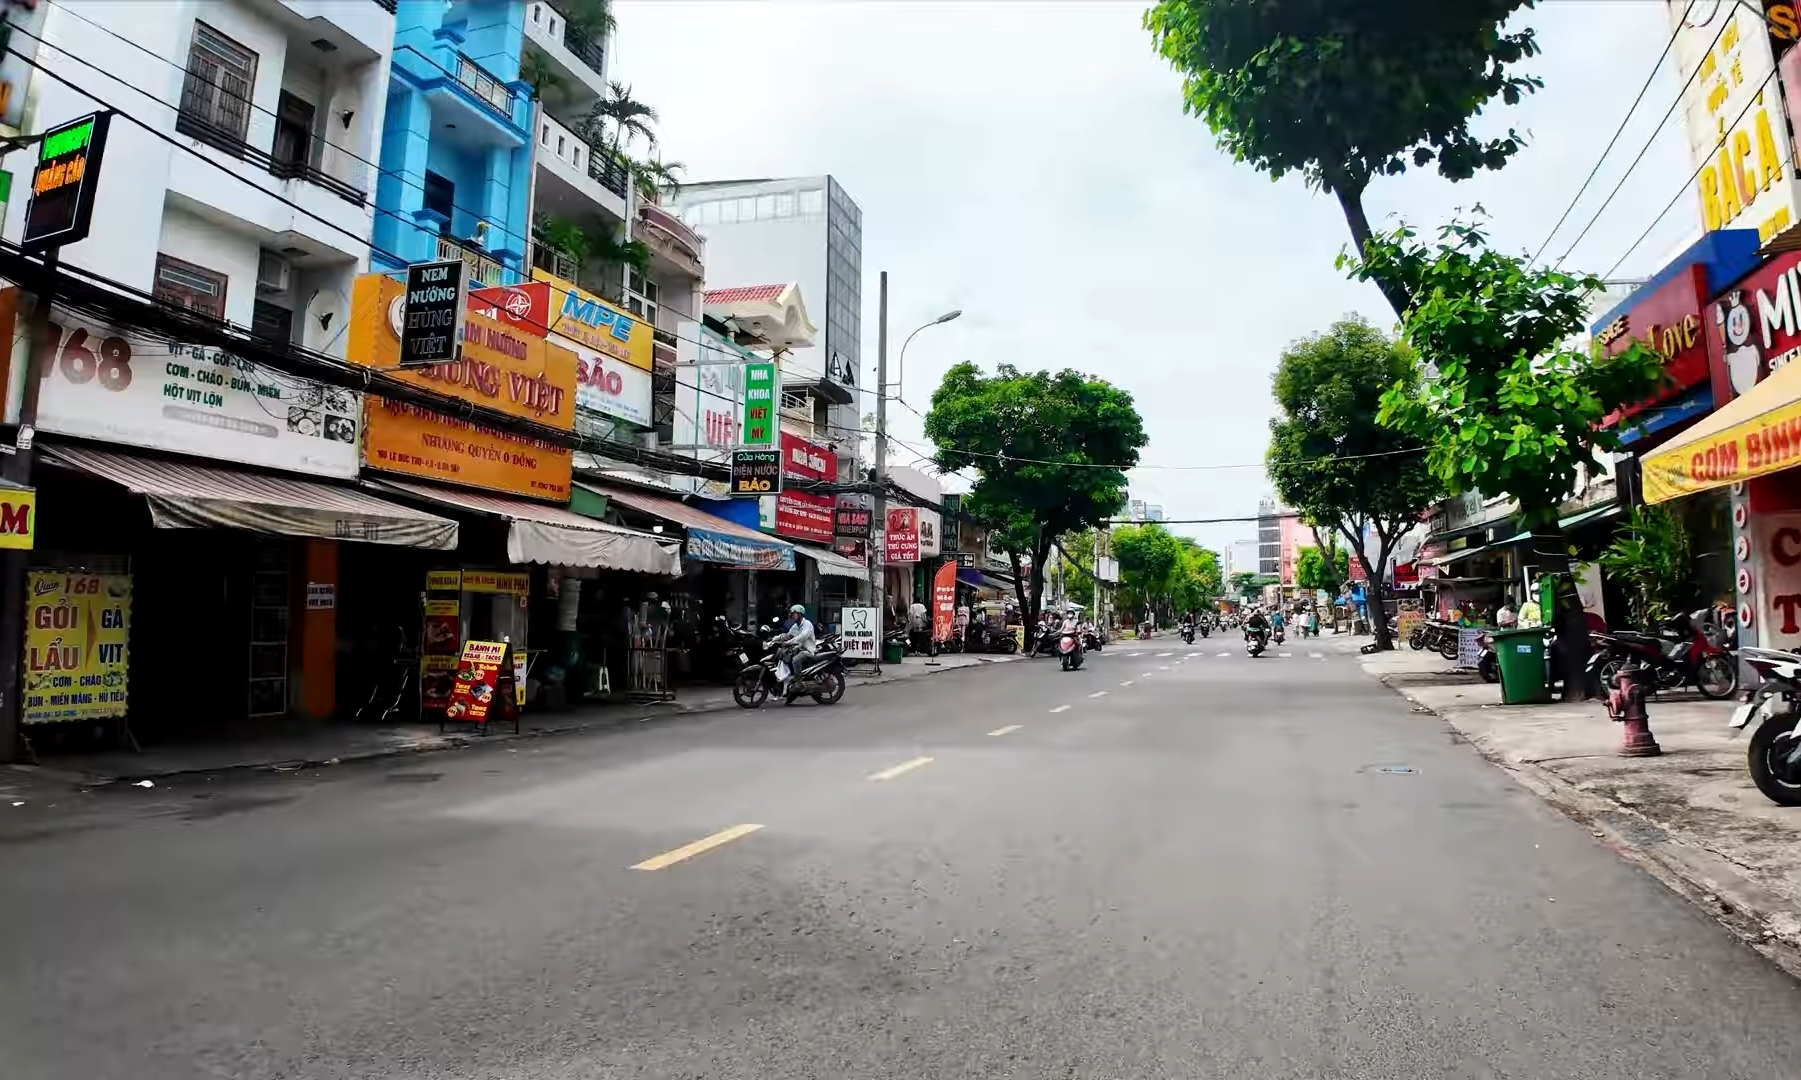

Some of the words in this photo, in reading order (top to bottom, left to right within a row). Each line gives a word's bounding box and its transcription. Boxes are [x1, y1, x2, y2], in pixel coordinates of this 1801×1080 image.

[422, 267, 448, 283] NEM
[410, 286, 456, 305] NƯỚNG
[1756, 261, 1801, 349] MI
[408, 307, 453, 329] HÙNG
[561, 288, 633, 342] MPE
[411, 331, 447, 359] VIỆT
[166, 362, 190, 379] CƠM
[197, 369, 223, 386] CHÁO
[751, 369, 768, 381] NHA
[164, 382, 184, 401] HỘT
[186, 388, 201, 405] VỊT
[748, 388, 770, 400] KHOA
[755, 453, 775, 463] Hàng
[1691, 440, 1738, 482] CƠM
[733, 463, 753, 477] ĐIỆN
[755, 463, 779, 476] NƯỚC
[738, 477, 771, 491] BẢO
[903, 552, 915, 560] TỐT
[64, 578, 100, 595] 168
[101, 606, 124, 629] GÀ
[857, 630, 873, 638] KHOA
[99, 644, 124, 668] VỊT
[52, 677, 72, 688] CƠM
